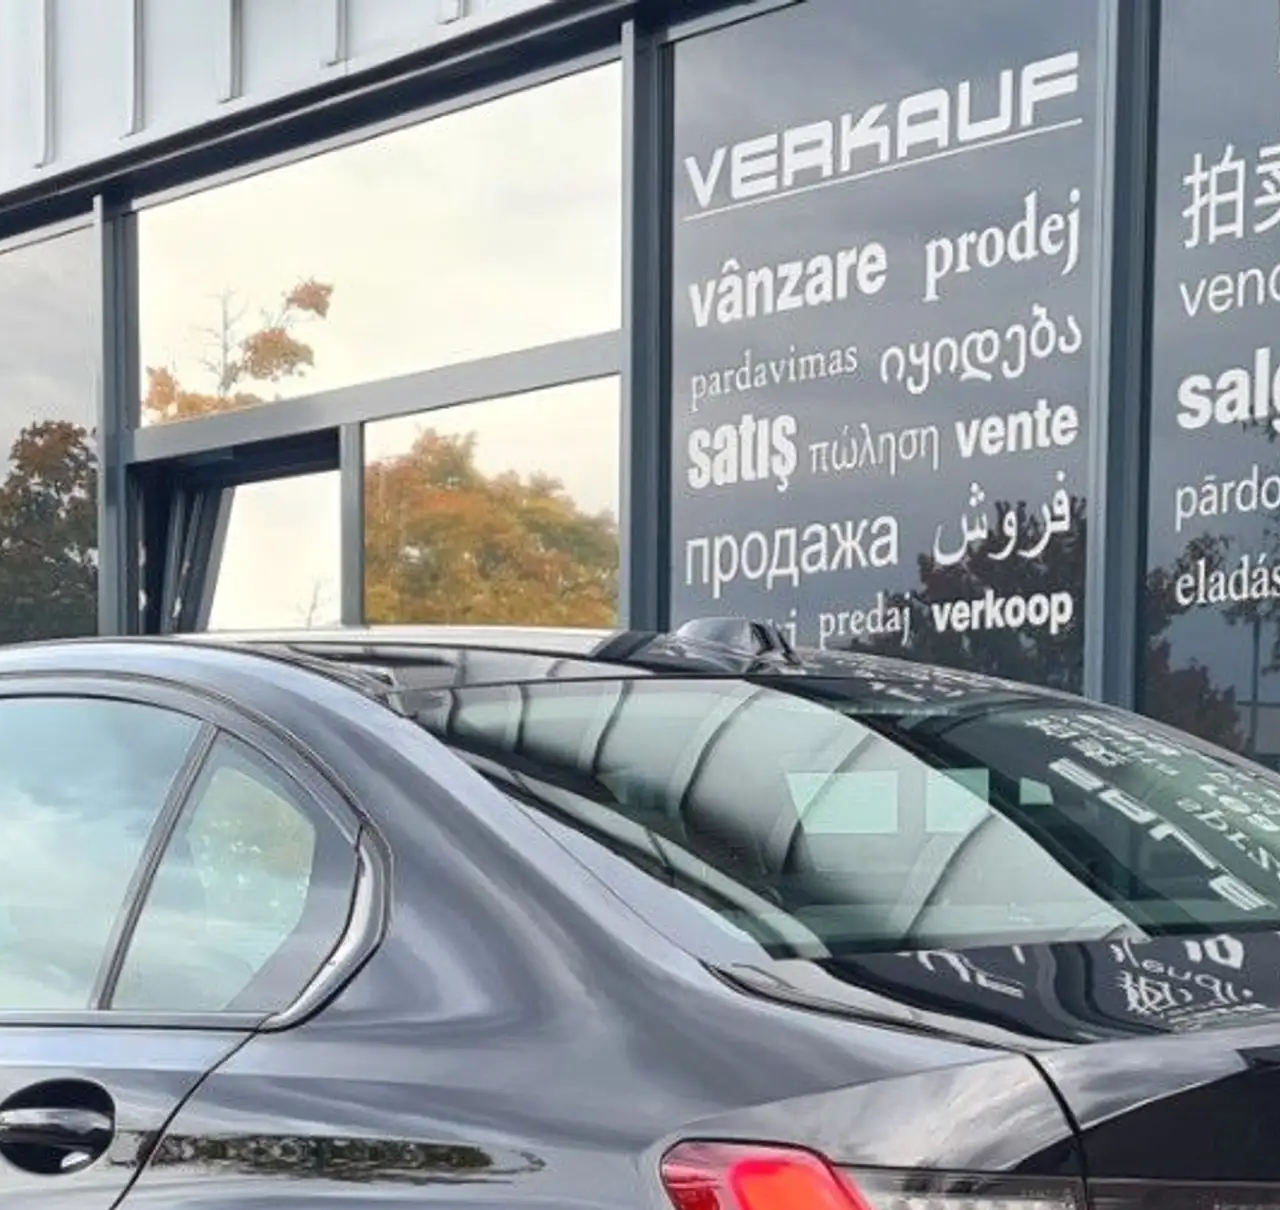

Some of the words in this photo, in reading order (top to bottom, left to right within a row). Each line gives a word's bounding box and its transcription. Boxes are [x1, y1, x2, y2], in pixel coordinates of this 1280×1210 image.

[684, 52, 1079, 208] VERKAUF
[688, 242, 887, 328] vânzare
[925, 188, 1081, 302] prodej
[690, 346, 858, 411] pardavimas
[880, 306, 1082, 395] იყიდება
[687, 413, 797, 493] satış
[808, 425, 939, 476] πώληση
[955, 399, 1079, 458] vente
[685, 515, 898, 597] продажа
[933, 470, 1072, 566] فروش
[820, 592, 912, 650] predaj
[931, 591, 1073, 635] verkoop
